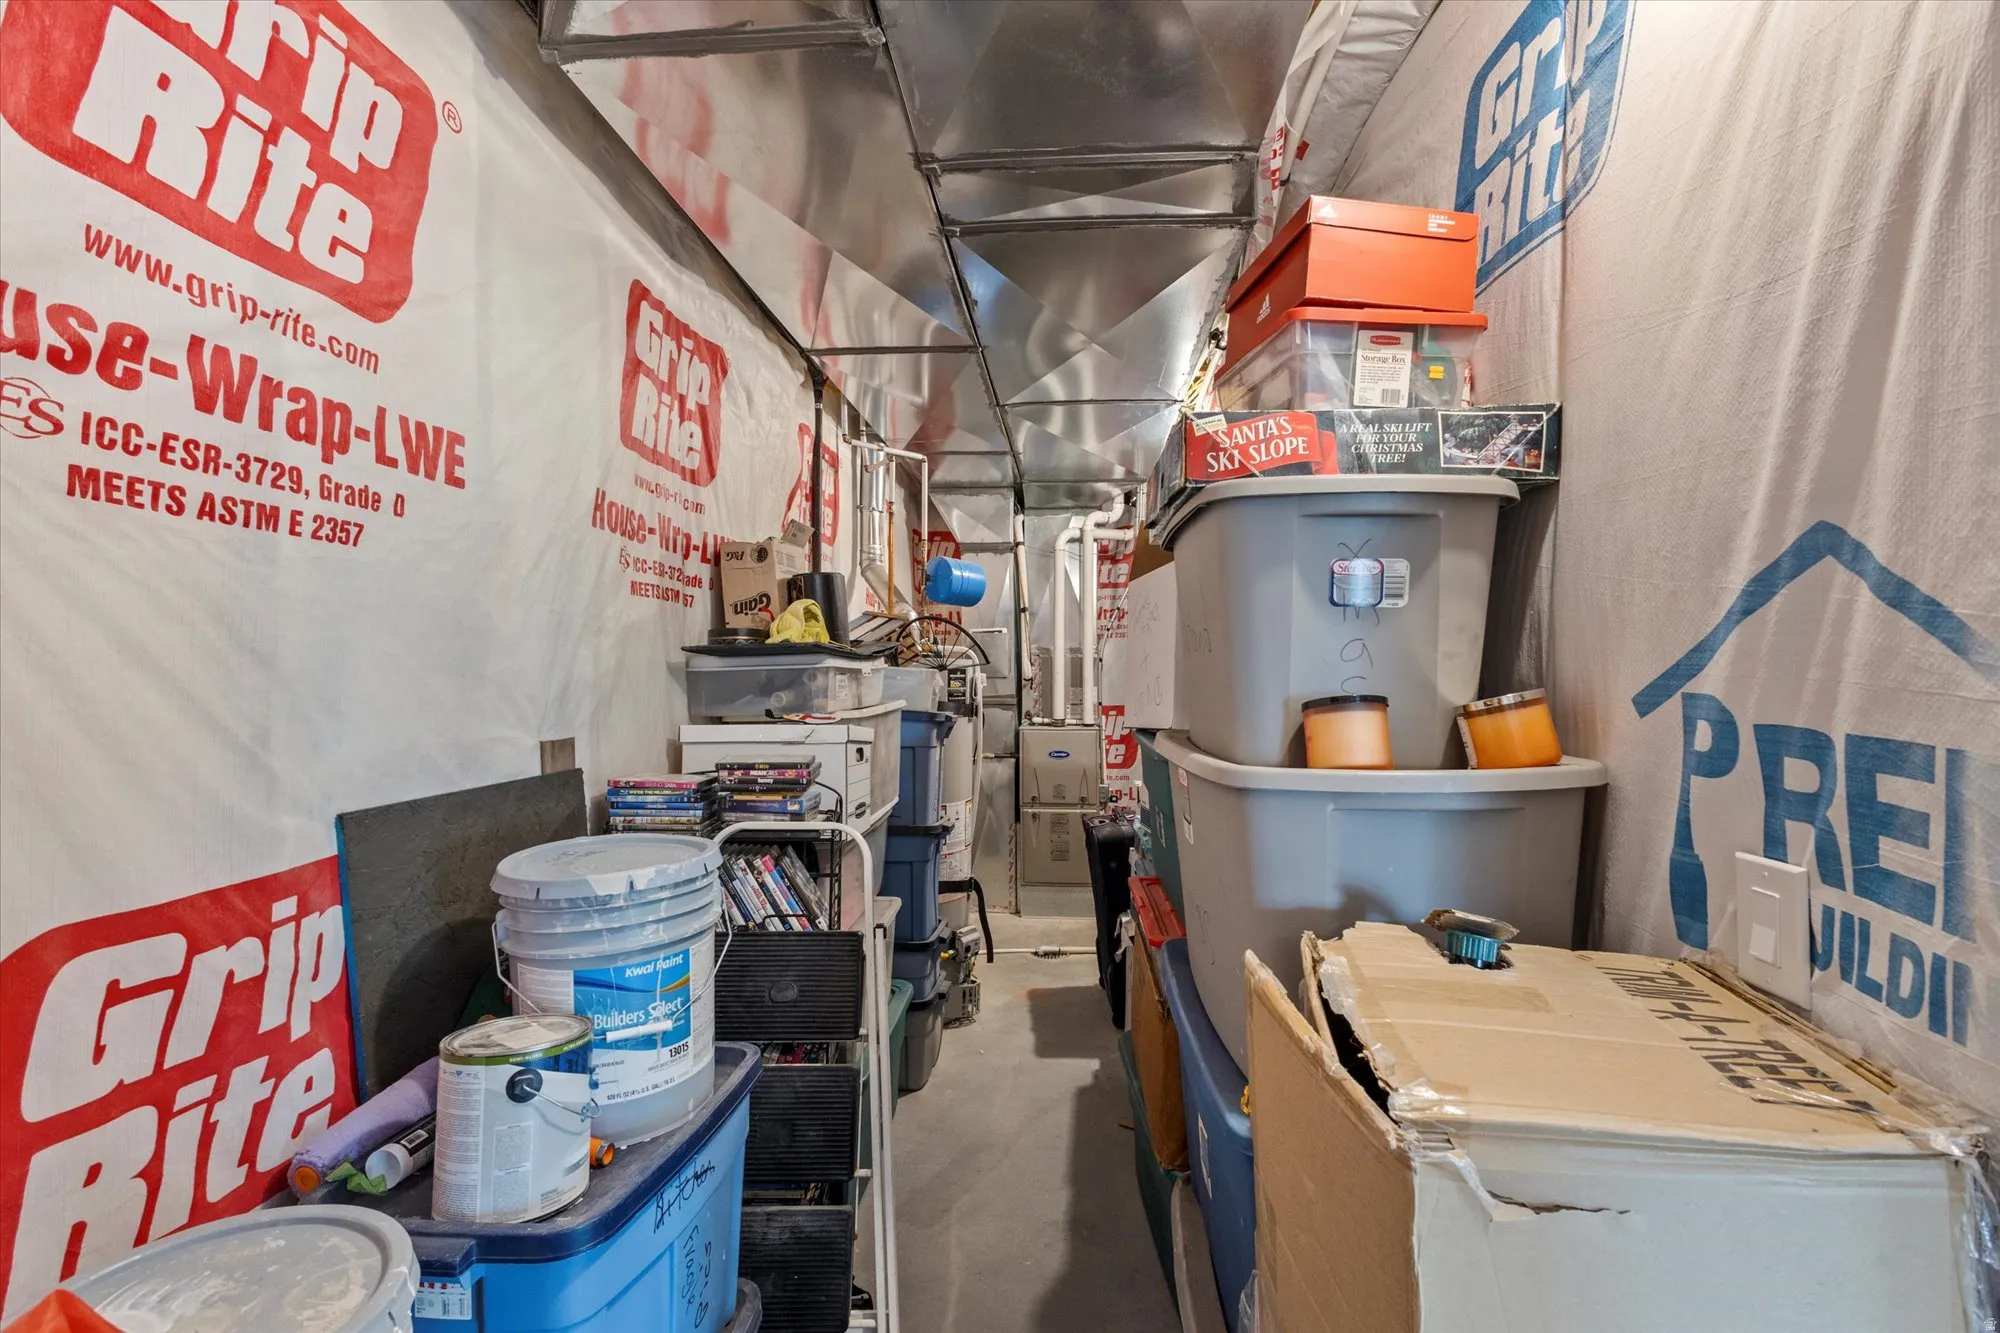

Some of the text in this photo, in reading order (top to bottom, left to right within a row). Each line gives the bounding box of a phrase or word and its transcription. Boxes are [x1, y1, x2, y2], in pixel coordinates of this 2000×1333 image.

[73, 5, 373, 284] Rite
[85, 224, 380, 375] www.grip-rite.com
[635, 300, 710, 413] Grip
[1361, 354, 1390, 363] Storage
[632, 374, 702, 470] Rite
[1217, 415, 1293, 449] SANTA'S
[1340, 423, 1432, 433] A REAL SKI LIFT
[1356, 433, 1417, 443] FOR YOUR
[81, 411, 310, 500] ICC-ESR-3729,
[319, 473, 381, 513] Grade
[1207, 437, 1309, 473] SKI SLOPE
[1351, 442, 1424, 453] CHRISTMAS
[1371, 453, 1406, 463] TREE!
[66, 464, 365, 548] MEETS ASTM E 2357
[732, 591, 772, 616] Gain
[625, 954, 684, 978] Kwal Paint
[20, 895, 346, 1124] Grip
[594, 997, 682, 1030] Builders Select
[669, 1042, 689, 1058] 13015
[2, 1048, 336, 1321] Rite
